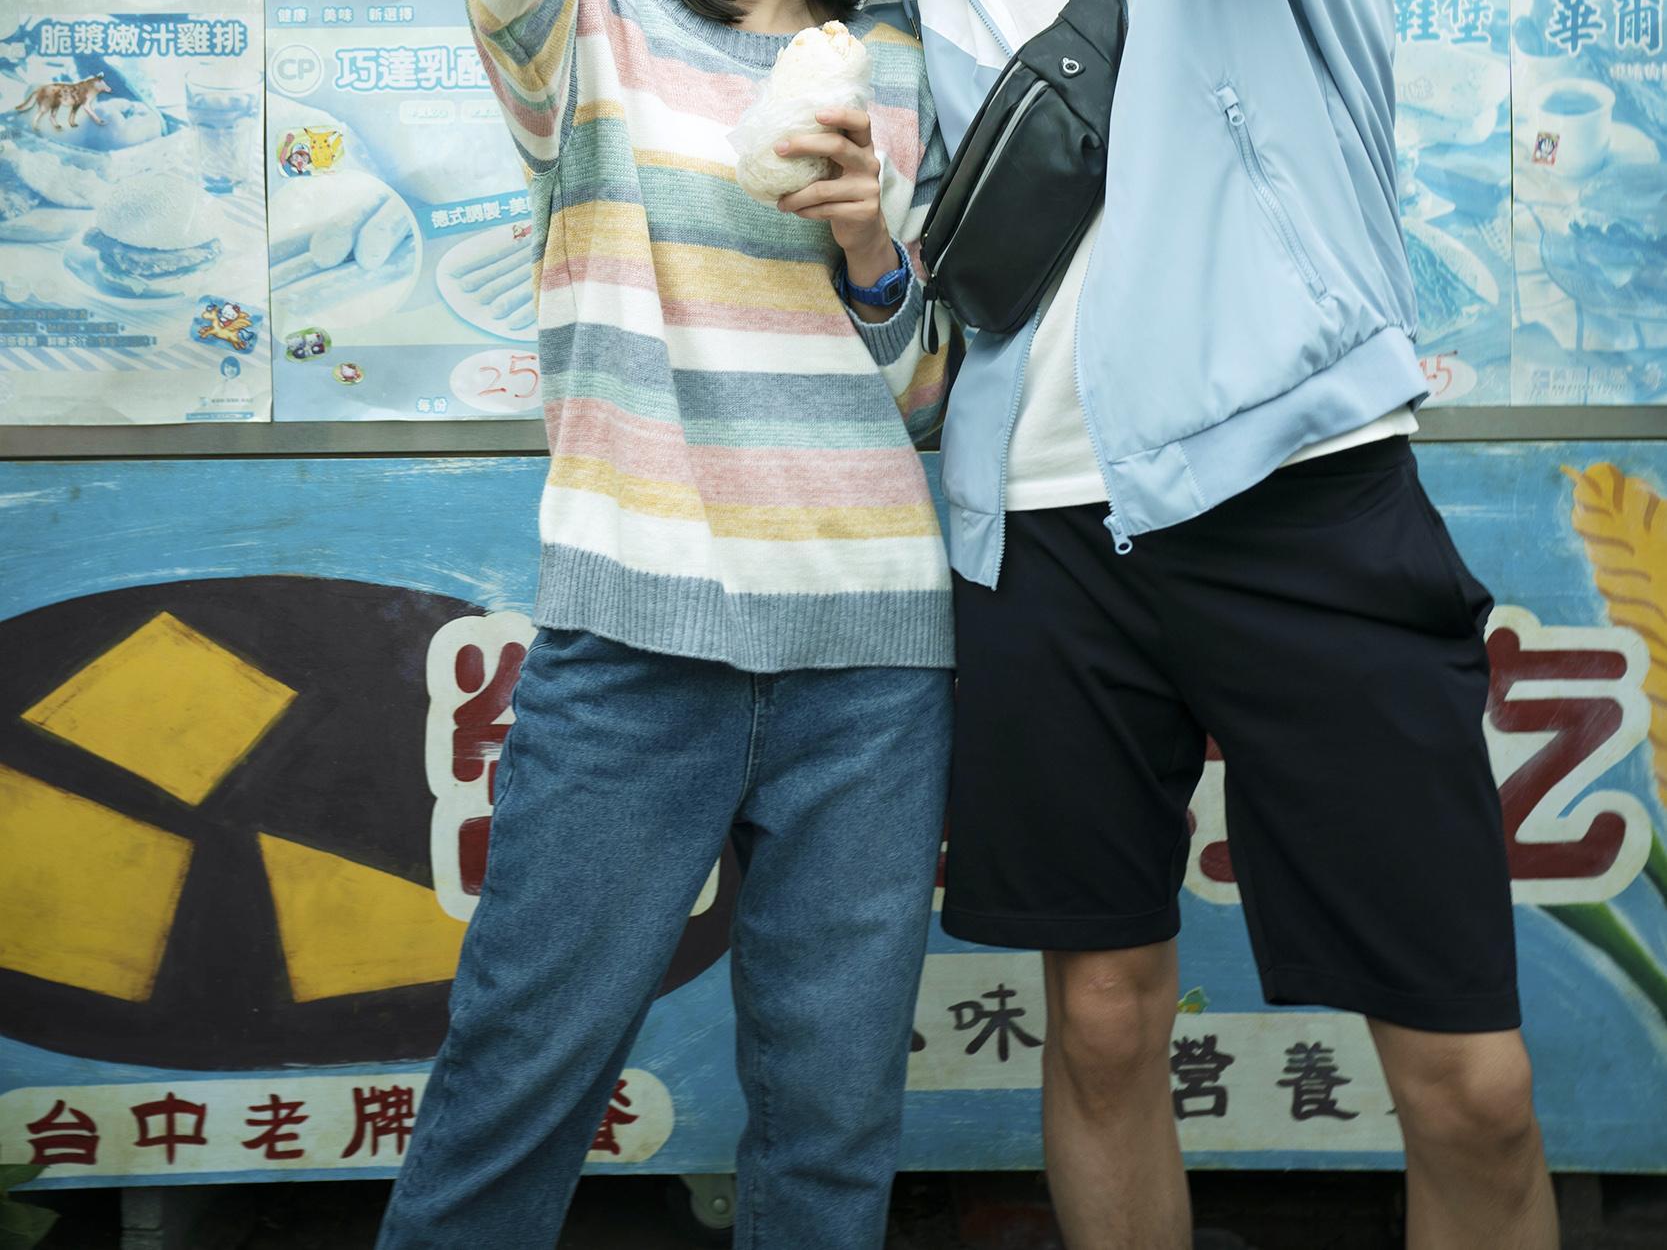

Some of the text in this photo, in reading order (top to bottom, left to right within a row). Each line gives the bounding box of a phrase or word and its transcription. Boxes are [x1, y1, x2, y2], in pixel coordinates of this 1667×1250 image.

[277, 6, 414, 23] 健康 美味 新選擇
[276, 58, 316, 81] CP
[431, 195, 533, 229] 德式調製~美
[477, 354, 540, 399] 25
[1171, 1034, 1397, 1121] 營養
[27, 1079, 640, 1166] 台中老牌
